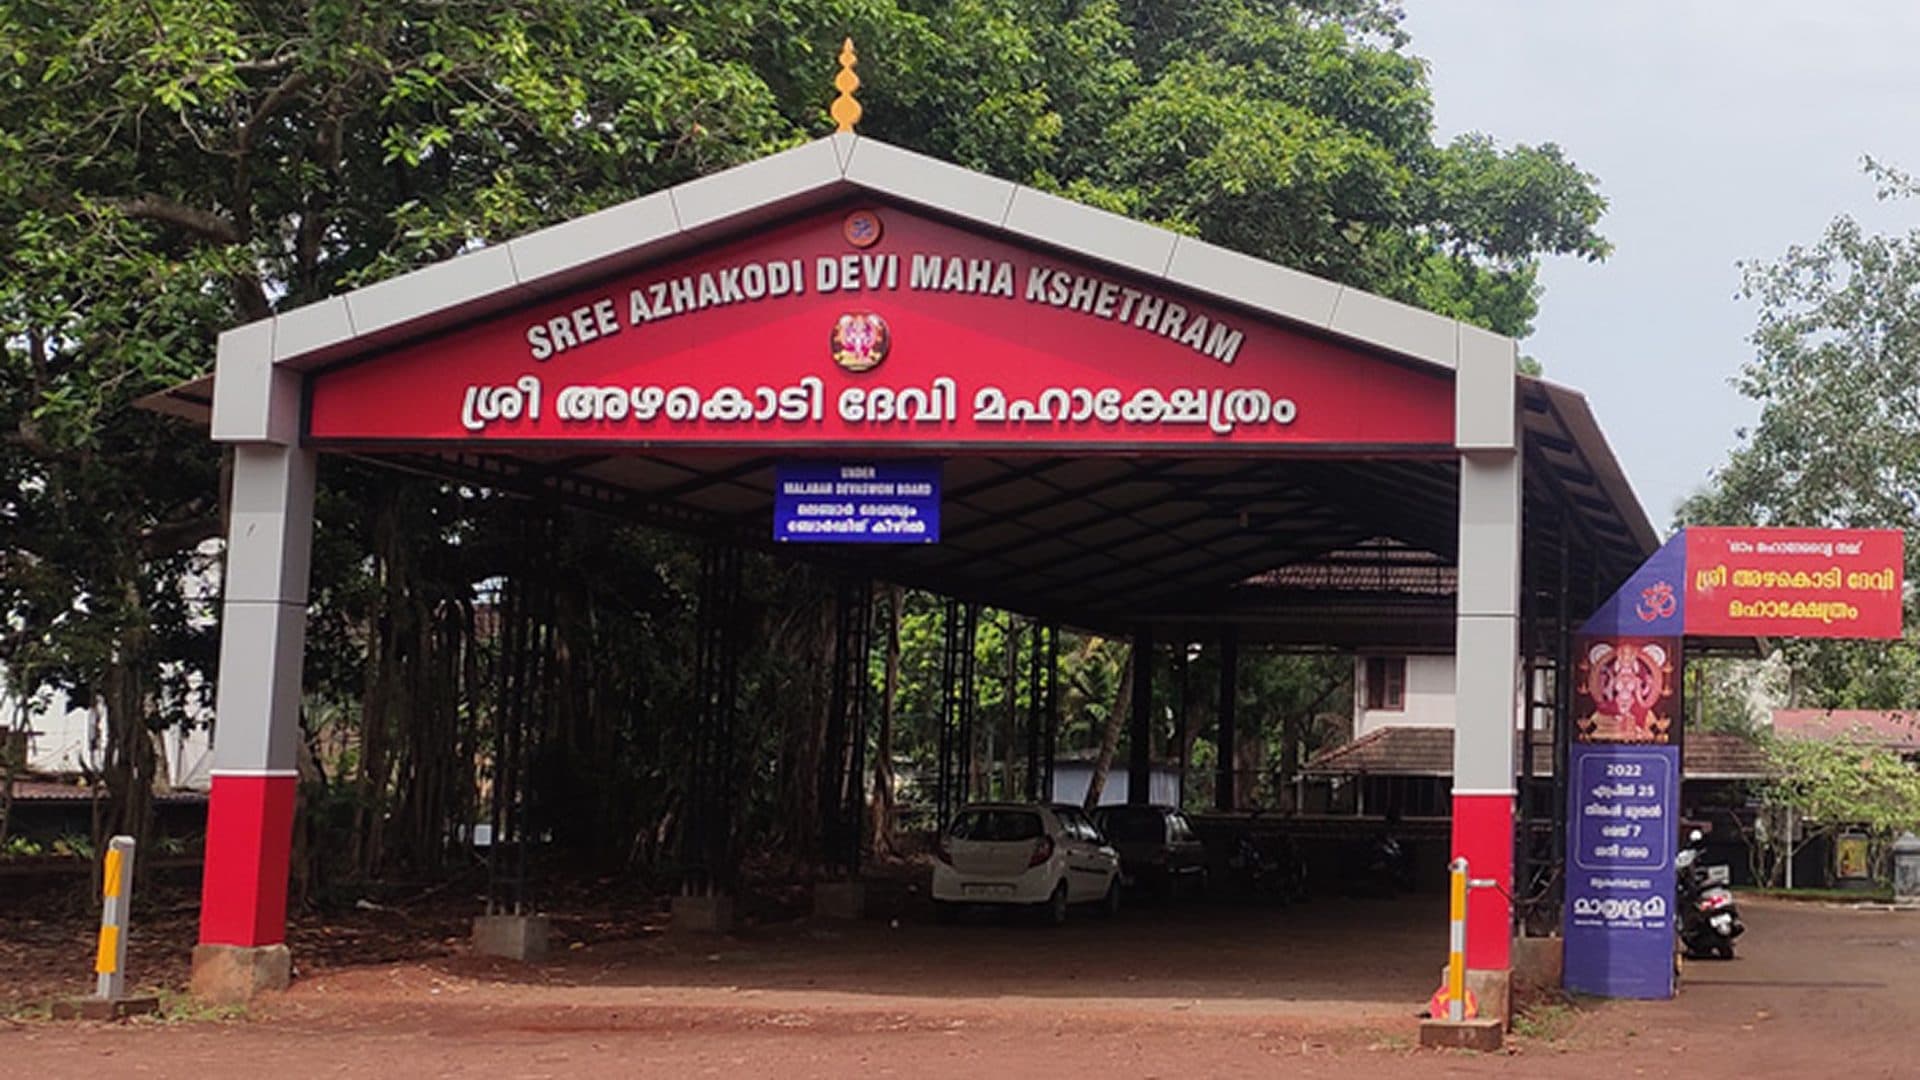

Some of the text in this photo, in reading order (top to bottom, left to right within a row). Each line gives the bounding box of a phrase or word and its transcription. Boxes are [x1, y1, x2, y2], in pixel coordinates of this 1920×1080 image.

[527, 253, 1245, 365] SREE AZHAKODI DEVI MAHA KSHETHRAM
[462, 375, 1297, 434] ശ്രീ അഴകൊടി ദേവി മഹാക്ഷേത്രം
[1695, 564, 1895, 592] ശ്രീ അഴകൊടി ദേവി
[1728, 600, 1858, 624] മഹാക്ഷേത്രം
[1606, 764, 1641, 777] 2022
[1637, 784, 1655, 797] 25
[1632, 824, 1641, 838] 7
[1574, 895, 1666, 920] മാതൃഭൂമി
